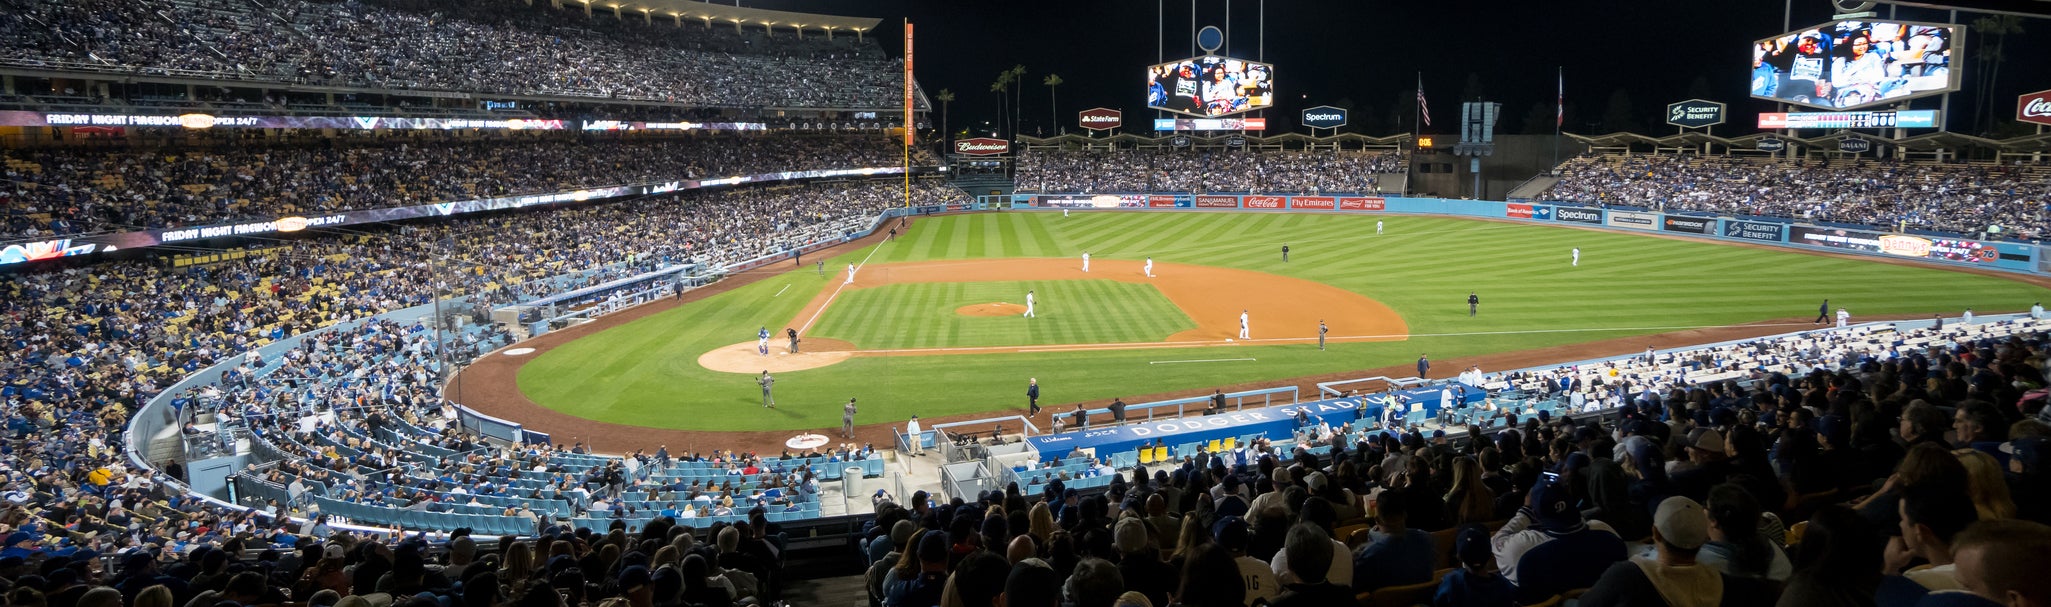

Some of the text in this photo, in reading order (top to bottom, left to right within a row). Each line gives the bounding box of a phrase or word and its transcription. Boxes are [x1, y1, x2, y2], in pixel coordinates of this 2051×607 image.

[46, 114, 90, 125] FRIDAY
[91, 114, 127, 125] NIGHT
[236, 117, 258, 126] 24/7
[1305, 113, 1341, 122] Spectrum
[957, 142, 1006, 151] Budweiser
[1291, 199, 1303, 207] Fly
[1558, 209, 1599, 222] Spectrum
[162, 228, 199, 242] FRIDAY
[200, 225, 233, 238] NIGHT
[325, 214, 346, 224] 24/7
[1743, 222, 1779, 233] SECURITY
[1742, 231, 1774, 240] BENEFIT
[1883, 237, 1927, 255] Denny's
[1983, 250, 1995, 258] 76
[1131, 392, 1413, 437] DODGER STADIU
